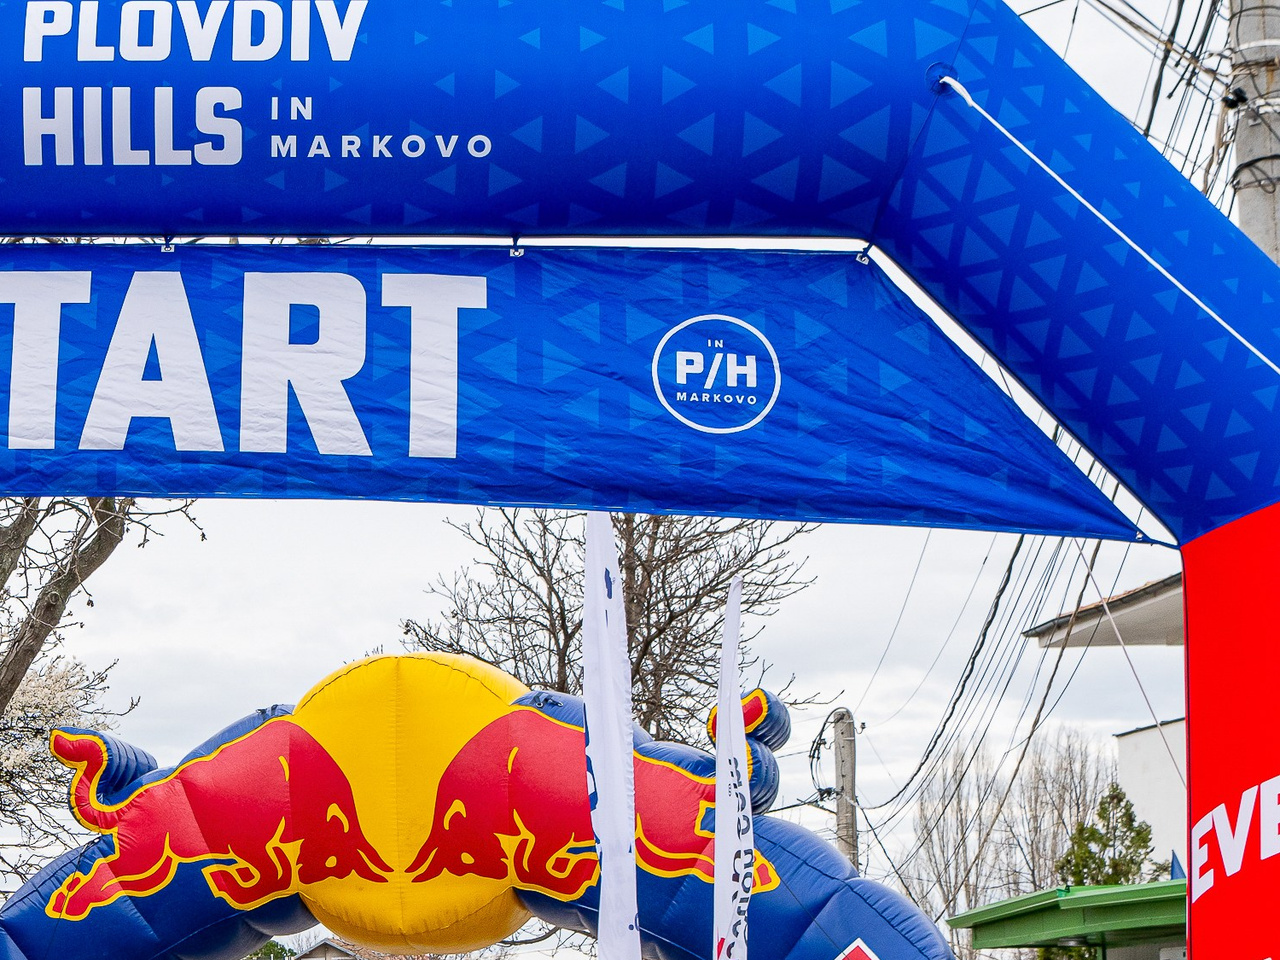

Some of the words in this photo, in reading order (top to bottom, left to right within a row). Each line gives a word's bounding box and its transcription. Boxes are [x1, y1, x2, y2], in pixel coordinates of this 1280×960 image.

[23, 0, 368, 62] PLOVDIV
[271, 97, 313, 120] IN
[23, 86, 243, 166] HILLS
[271, 135, 494, 158] MARKOVO
[707, 339, 724, 348] IN
[676, 351, 757, 390] P/H
[676, 392, 757, 405] MARKOVO
